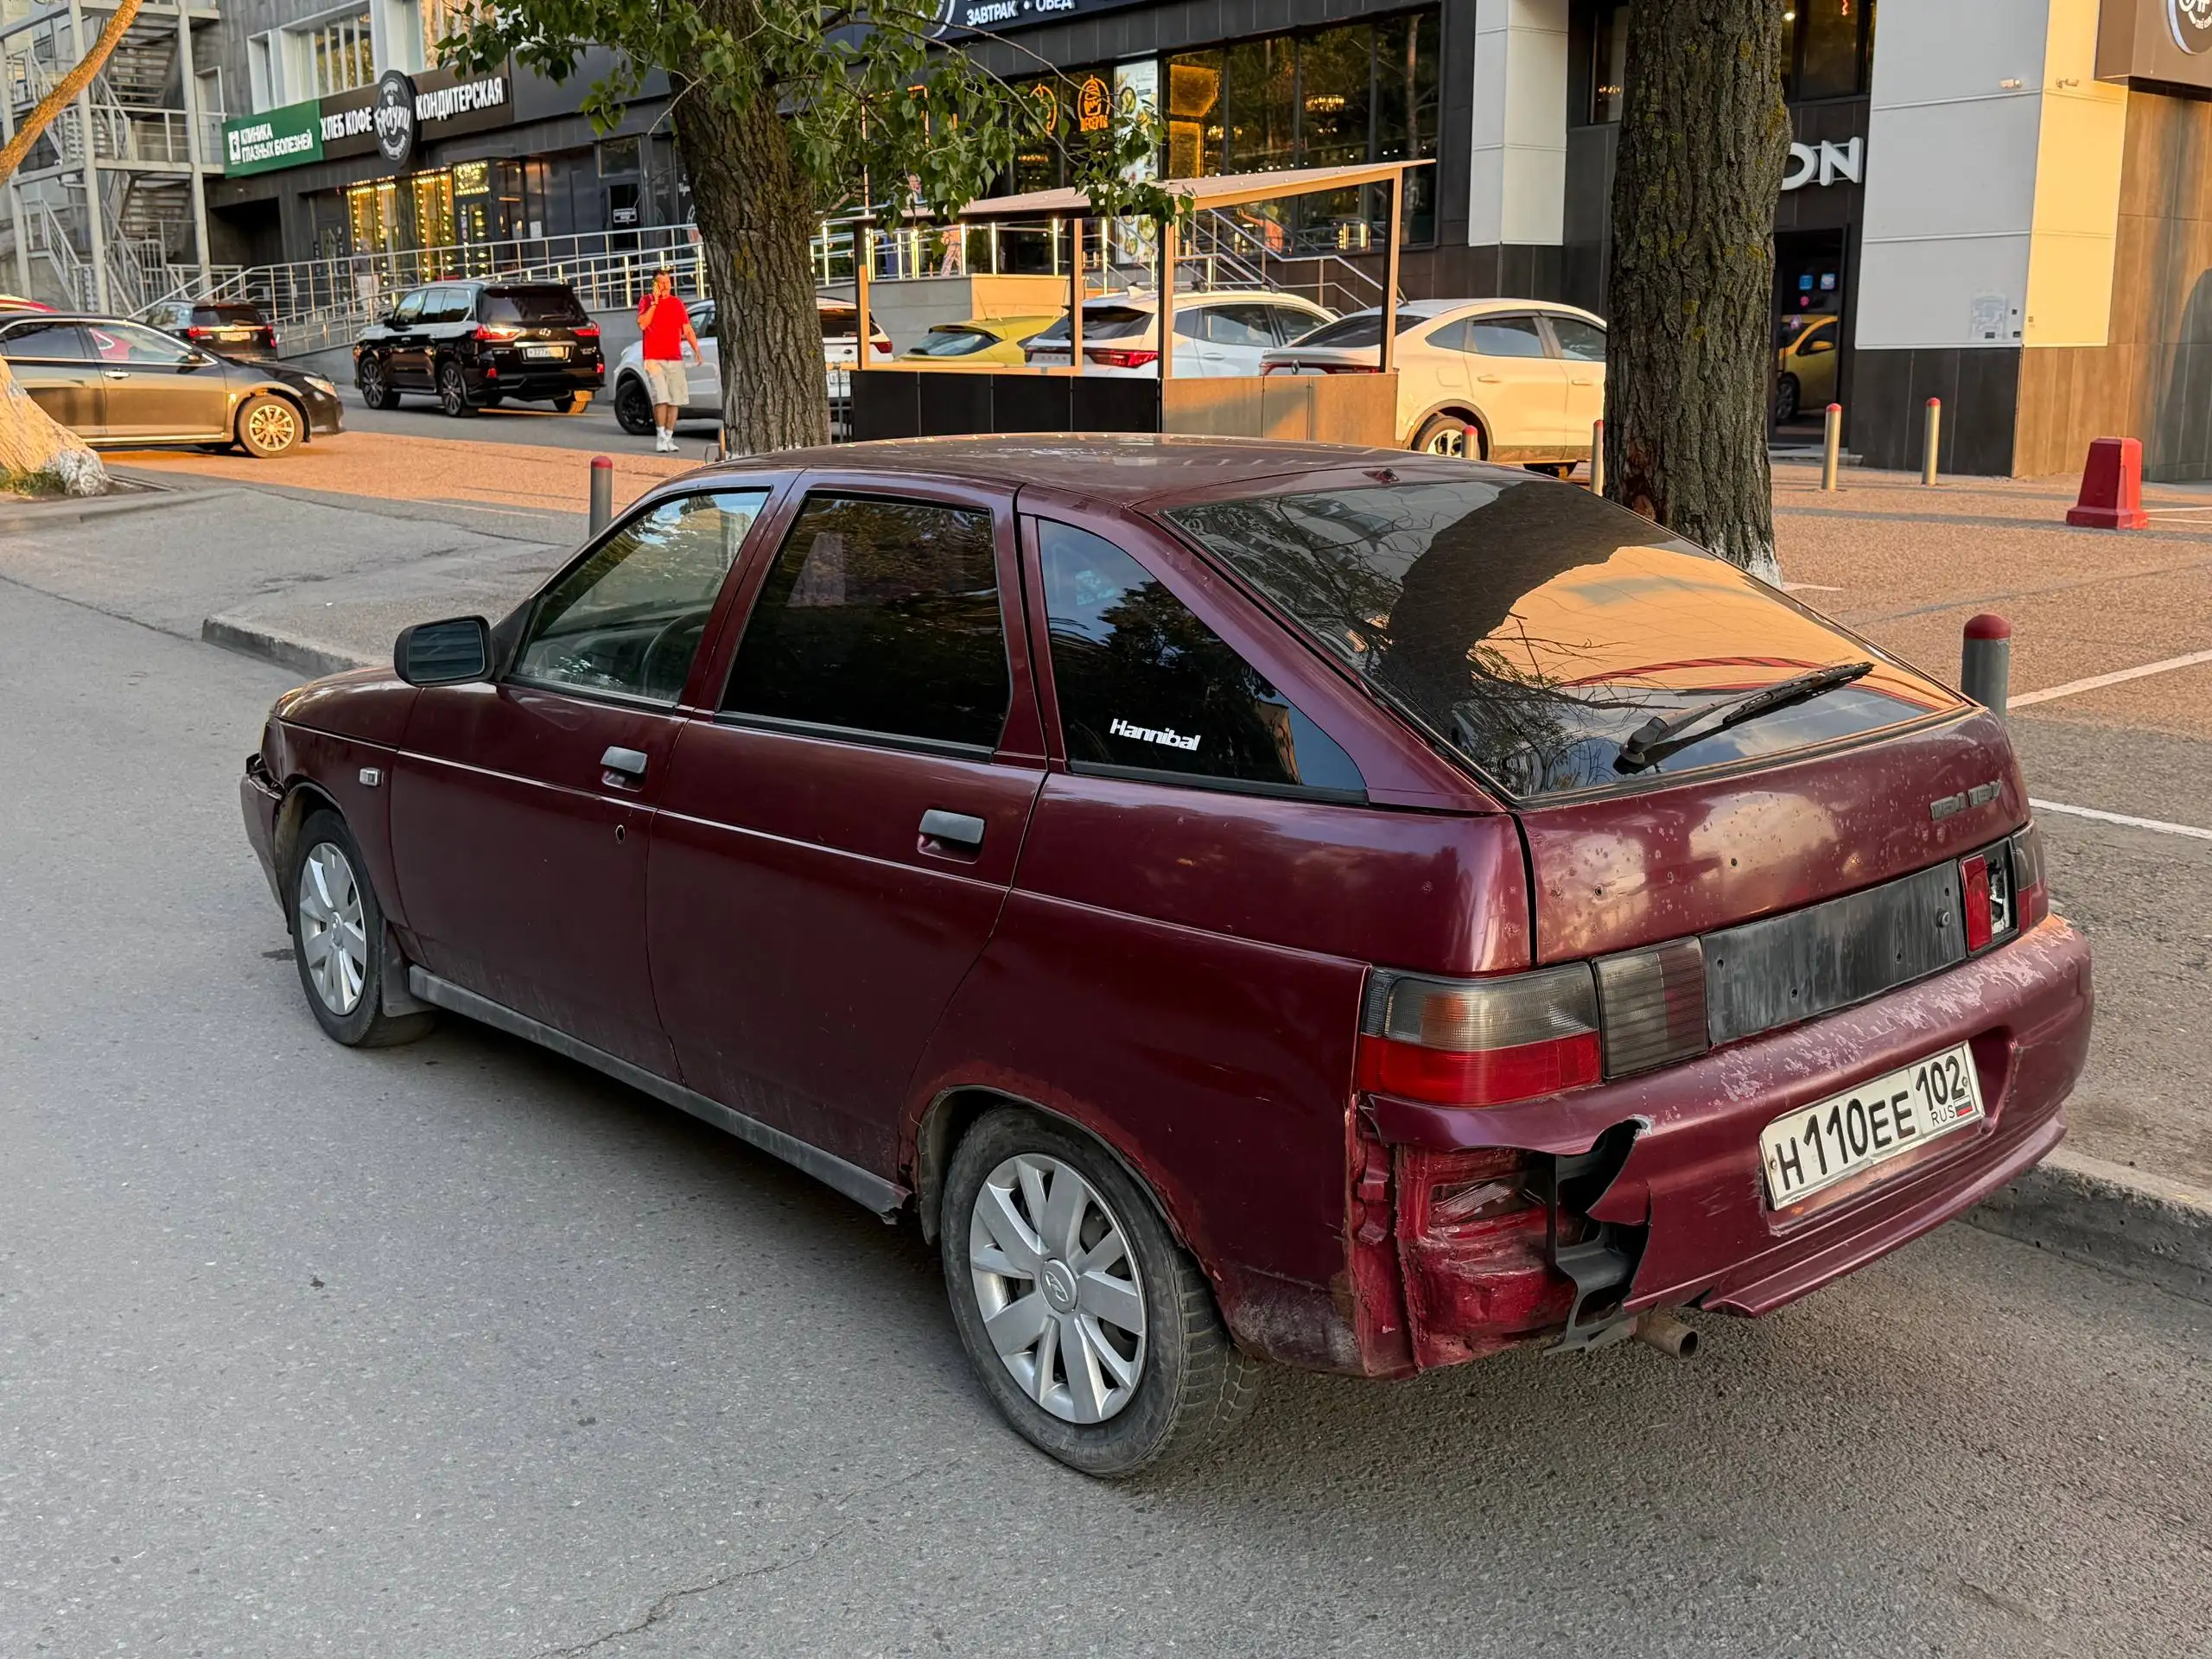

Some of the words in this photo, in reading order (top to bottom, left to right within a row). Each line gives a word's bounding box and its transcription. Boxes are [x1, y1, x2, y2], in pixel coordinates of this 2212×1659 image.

[966, 1, 1018, 27] ЗАВТРАК
[415, 77, 504, 121] КОНДИТЕРСКАЯ
[240, 123, 274, 145] КЛИНИКА
[320, 113, 345, 142] ХЛЕБ
[346, 106, 373, 137] КОФЕ
[241, 140, 275, 163] ГЛАЗНЫХ
[274, 128, 314, 156] БОЛЕЗНЕЙ
[1109, 718, 1202, 751] Hannibal
[1775, 1090, 1916, 1191] Н110ЕЕ
[1915, 1054, 1966, 1112] 102
[1931, 1103, 1956, 1128] RUS
